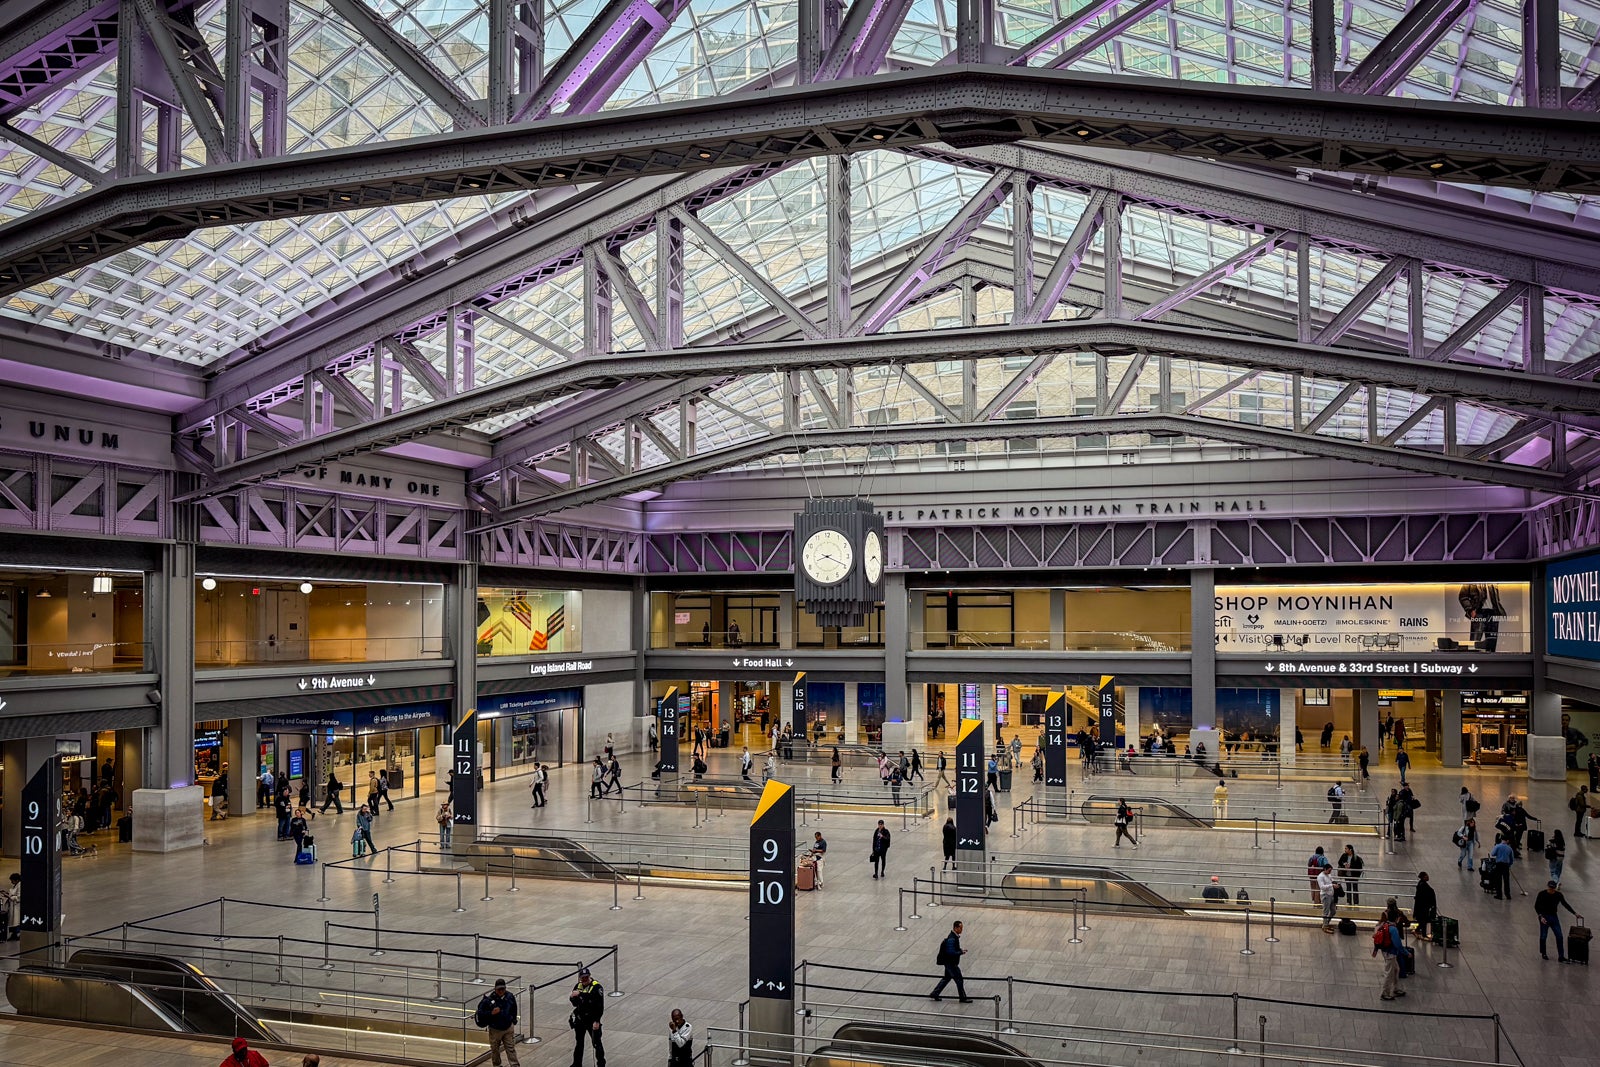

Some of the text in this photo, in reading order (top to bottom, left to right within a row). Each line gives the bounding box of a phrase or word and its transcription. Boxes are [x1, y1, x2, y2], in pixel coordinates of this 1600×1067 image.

[29, 421, 119, 450] UNUM
[340, 470, 393, 489] MANY
[407, 481, 440, 497] ONE
[917, 507, 1001, 520] PATRICK
[1014, 503, 1121, 518] MOYNIHAN
[1136, 502, 1199, 514] TRAIN
[1215, 500, 1267, 512] HALL
[1553, 570, 1600, 604] MOYNIH
[1215, 595, 1393, 610] SHOP MOYNIHAN
[1400, 617, 1428, 627] RAINS
[1552, 611, 1600, 642] TRAIN H
[1238, 634, 1260, 643] Visit
[1315, 634, 1341, 643] Level
[530, 660, 592, 676] Long Island Rail Road
[743, 658, 782, 667] Food Hall
[1279, 663, 1296, 673] 8th
[1298, 663, 1336, 673] Avenue
[1338, 663, 1347, 673] &
[1349, 663, 1373, 673] 33rd
[1376, 663, 1410, 673] Street
[1420, 663, 1463, 675] Subway
[311, 676, 364, 689] 9th Avenue
[795, 688, 804, 698] 15
[1102, 693, 1112, 703] 15
[795, 701, 804, 710] 16
[1102, 707, 1113, 717] 16
[381, 714, 398, 722] Getting
[412, 711, 431, 719] Airports
[664, 708, 675, 719] 13
[295, 717, 320, 725] Customer
[320, 718, 340, 726] Service
[1049, 715, 1062, 727] 13
[663, 724, 675, 735] 14
[458, 738, 469, 752] 11
[1049, 734, 1062, 746] 14
[962, 752, 977, 768] 11
[457, 761, 471, 775] 12
[961, 777, 978, 793] 12
[28, 801, 39, 820] 9
[25, 835, 43, 855] 10
[762, 838, 779, 863] 9
[757, 880, 784, 905] 10
